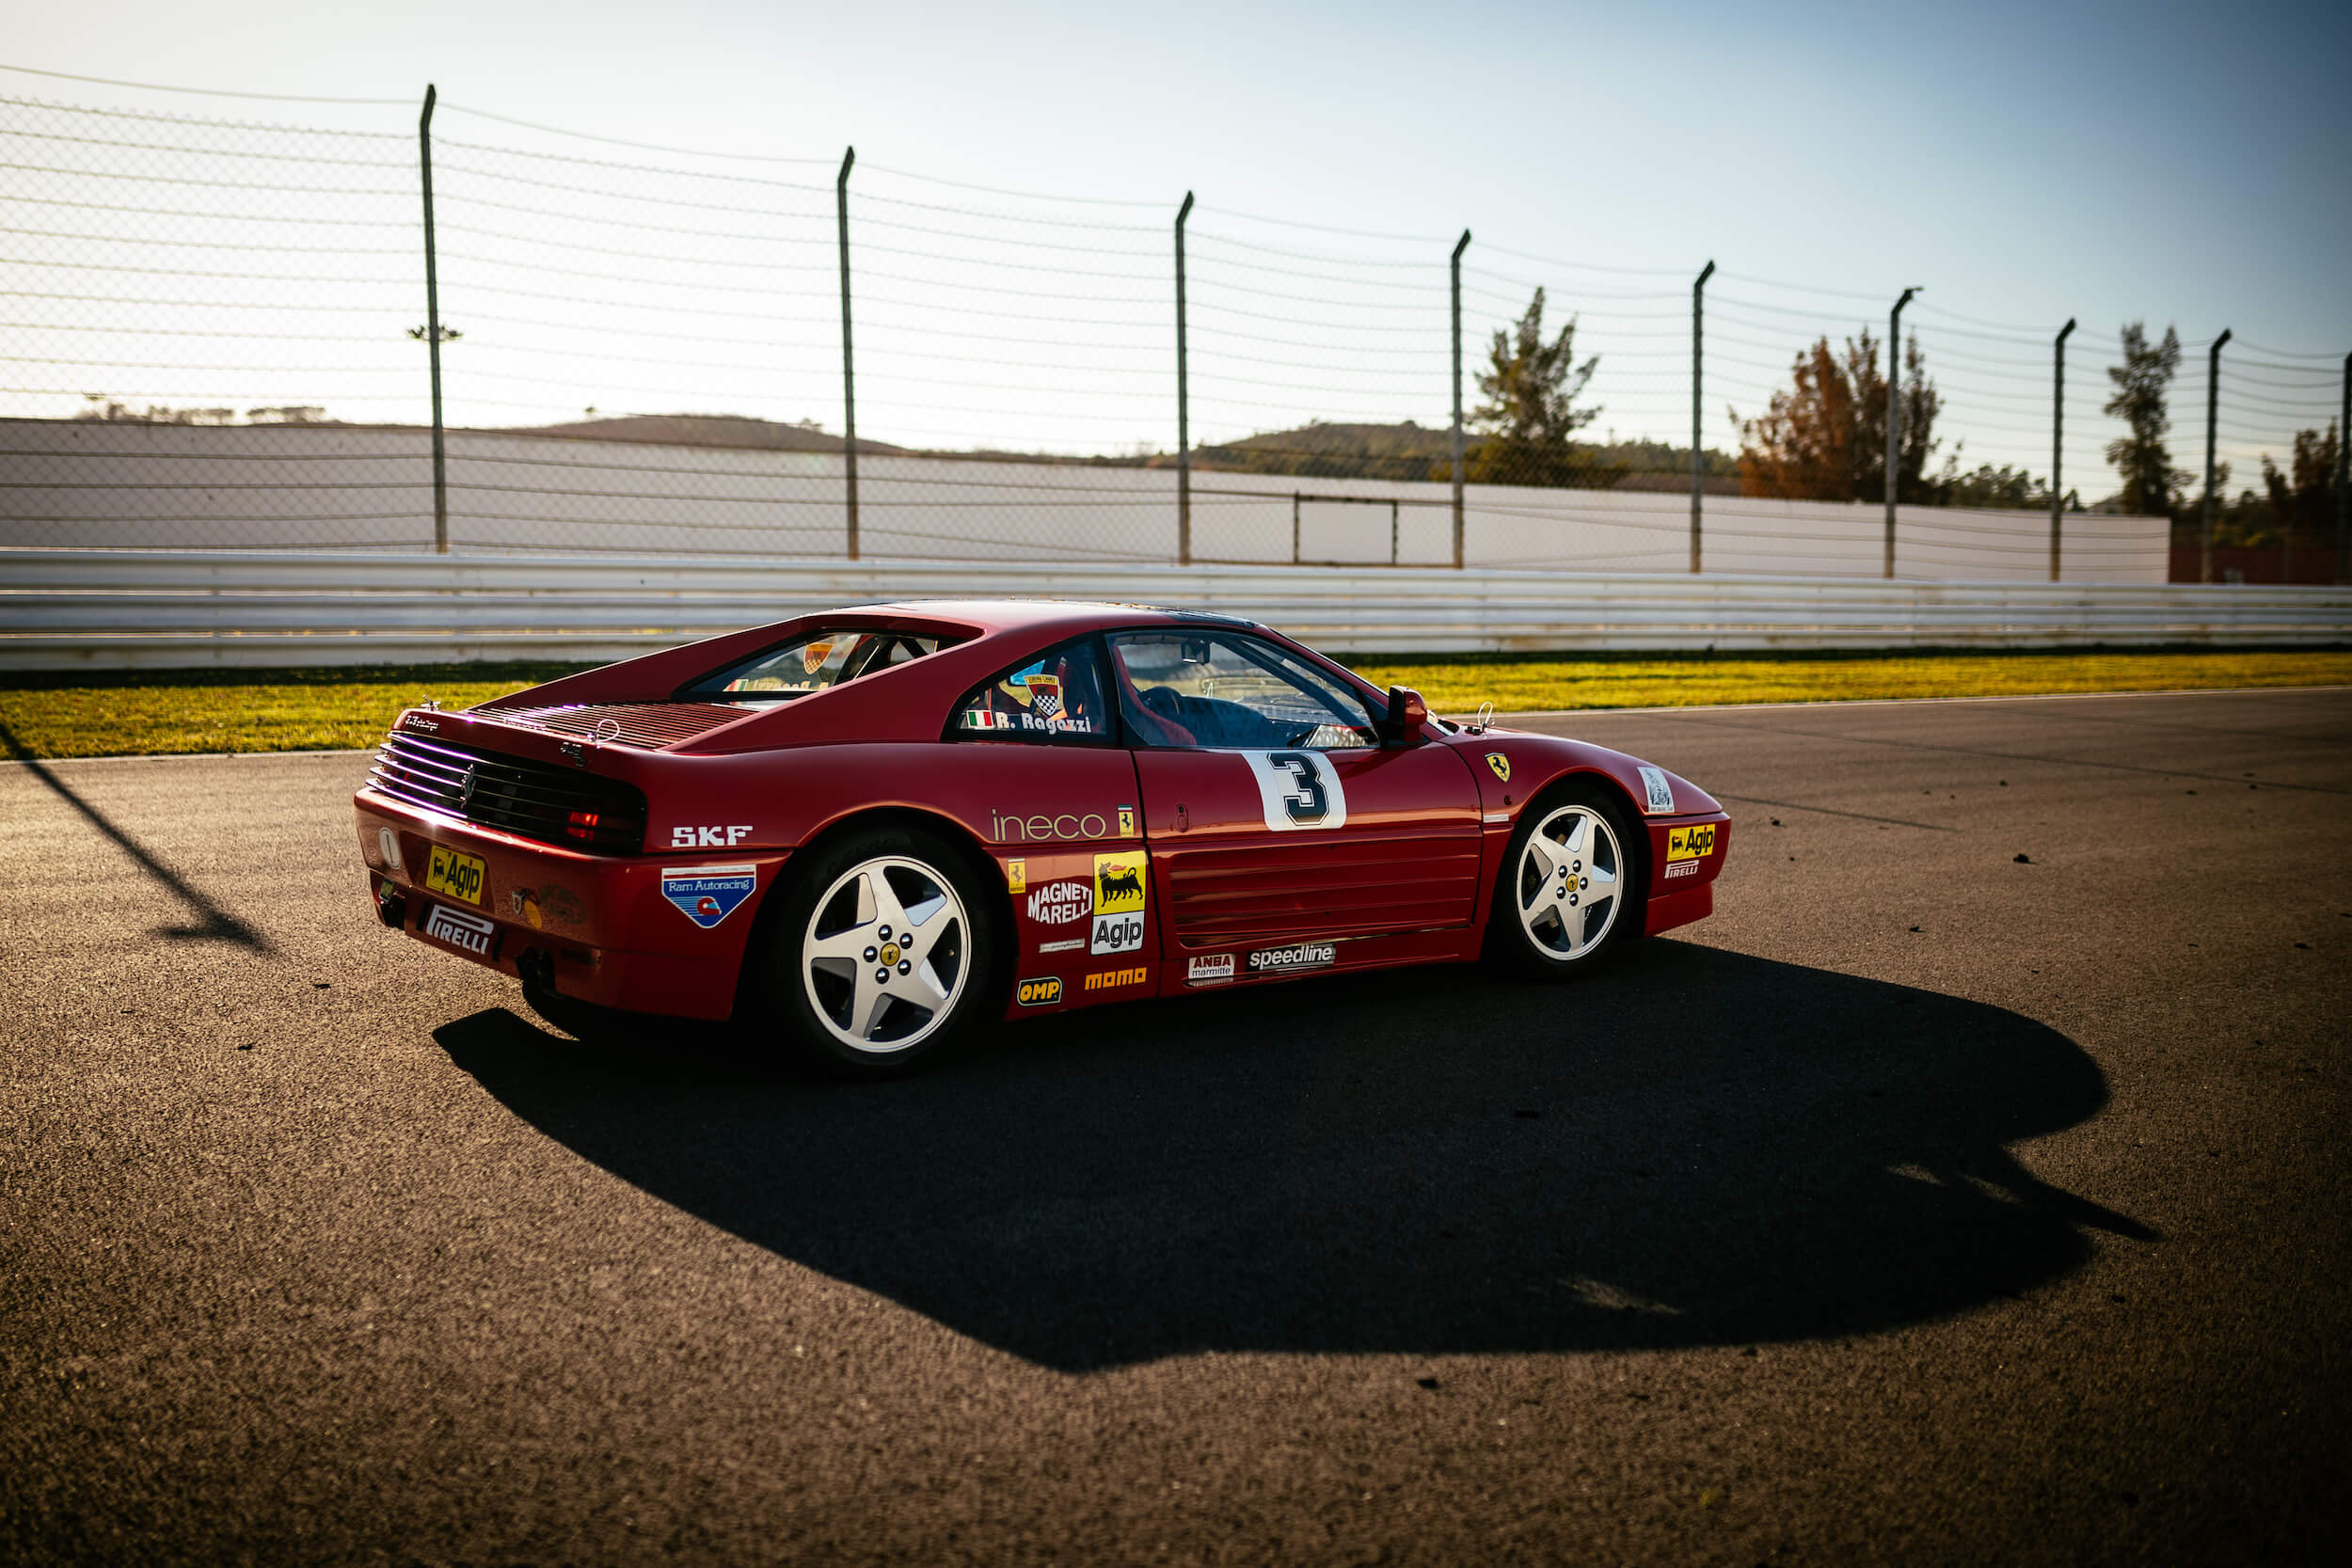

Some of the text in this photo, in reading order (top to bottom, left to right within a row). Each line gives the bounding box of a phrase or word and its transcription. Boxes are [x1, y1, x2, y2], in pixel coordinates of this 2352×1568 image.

[995, 711, 1092, 735] R. Ragazzi
[1266, 752, 1329, 826] 3
[672, 826, 753, 847] SKF
[991, 808, 1106, 841] ineco
[1685, 827, 1713, 856] Agip
[445, 853, 481, 899] Agip
[1664, 860, 1699, 879] PIRELLI
[669, 879, 750, 892] Ram Autoracing
[1027, 882, 1092, 912] MAGNETI
[1027, 896, 1092, 924] MARELLI
[426, 904, 494, 955] PIRELLI
[1094, 918, 1142, 949] Agip
[1249, 944, 1333, 971] speedline
[1019, 981, 1060, 1002] OMP
